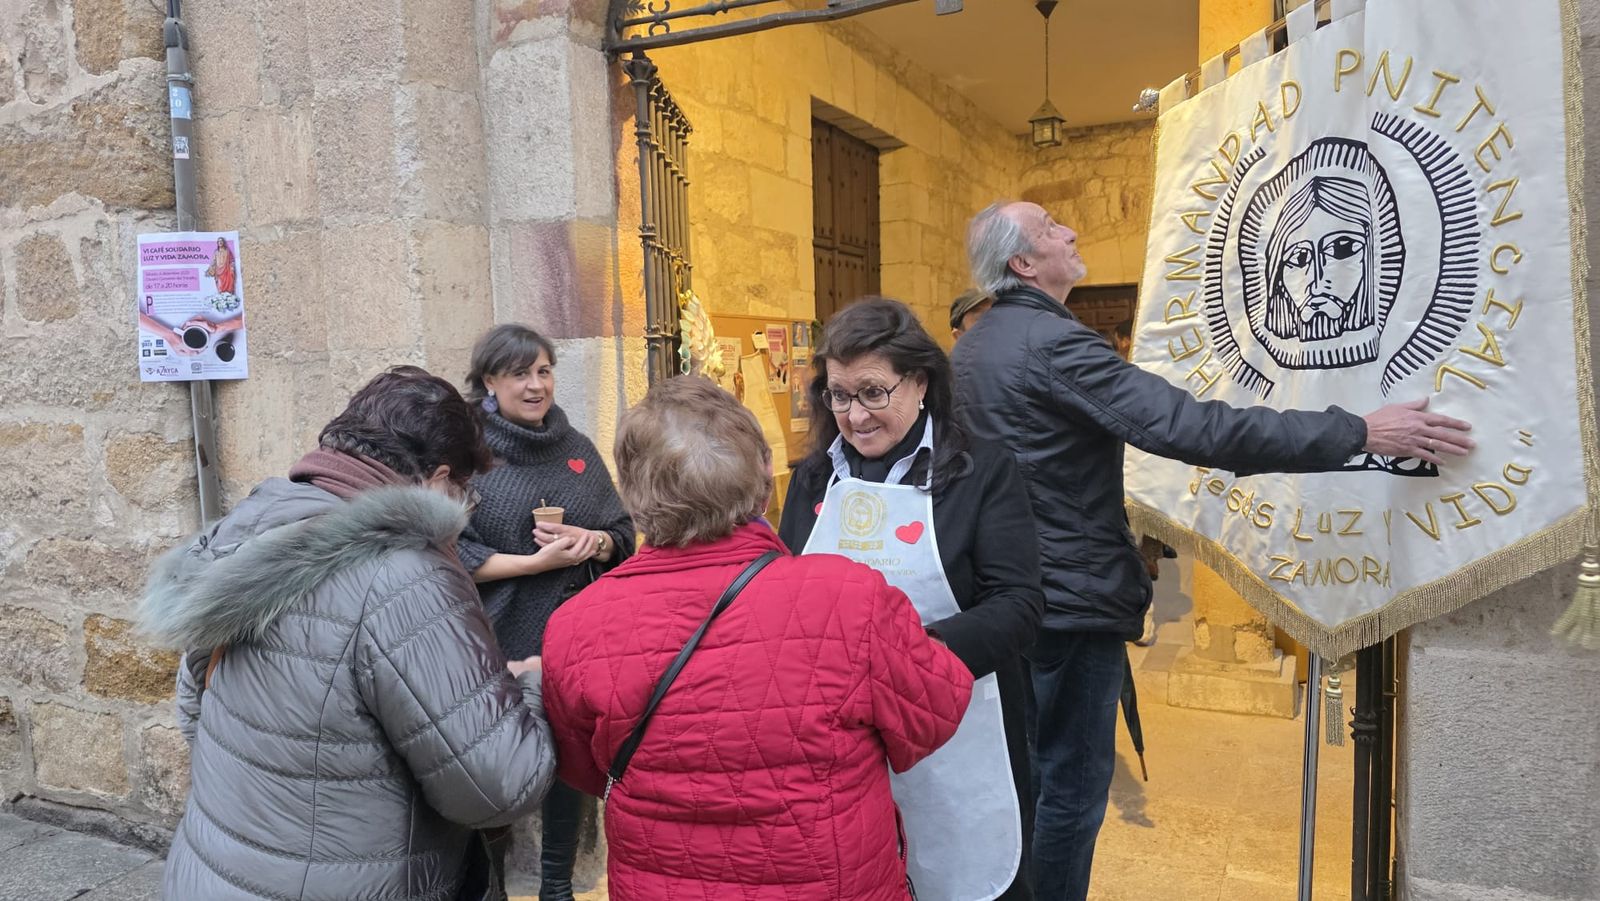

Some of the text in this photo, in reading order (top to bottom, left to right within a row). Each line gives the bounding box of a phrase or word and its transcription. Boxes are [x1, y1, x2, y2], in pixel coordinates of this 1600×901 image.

[1164, 48, 1523, 397] HERMANDAD PNITENCIAL
[1268, 554, 1393, 588] ZAMORA
